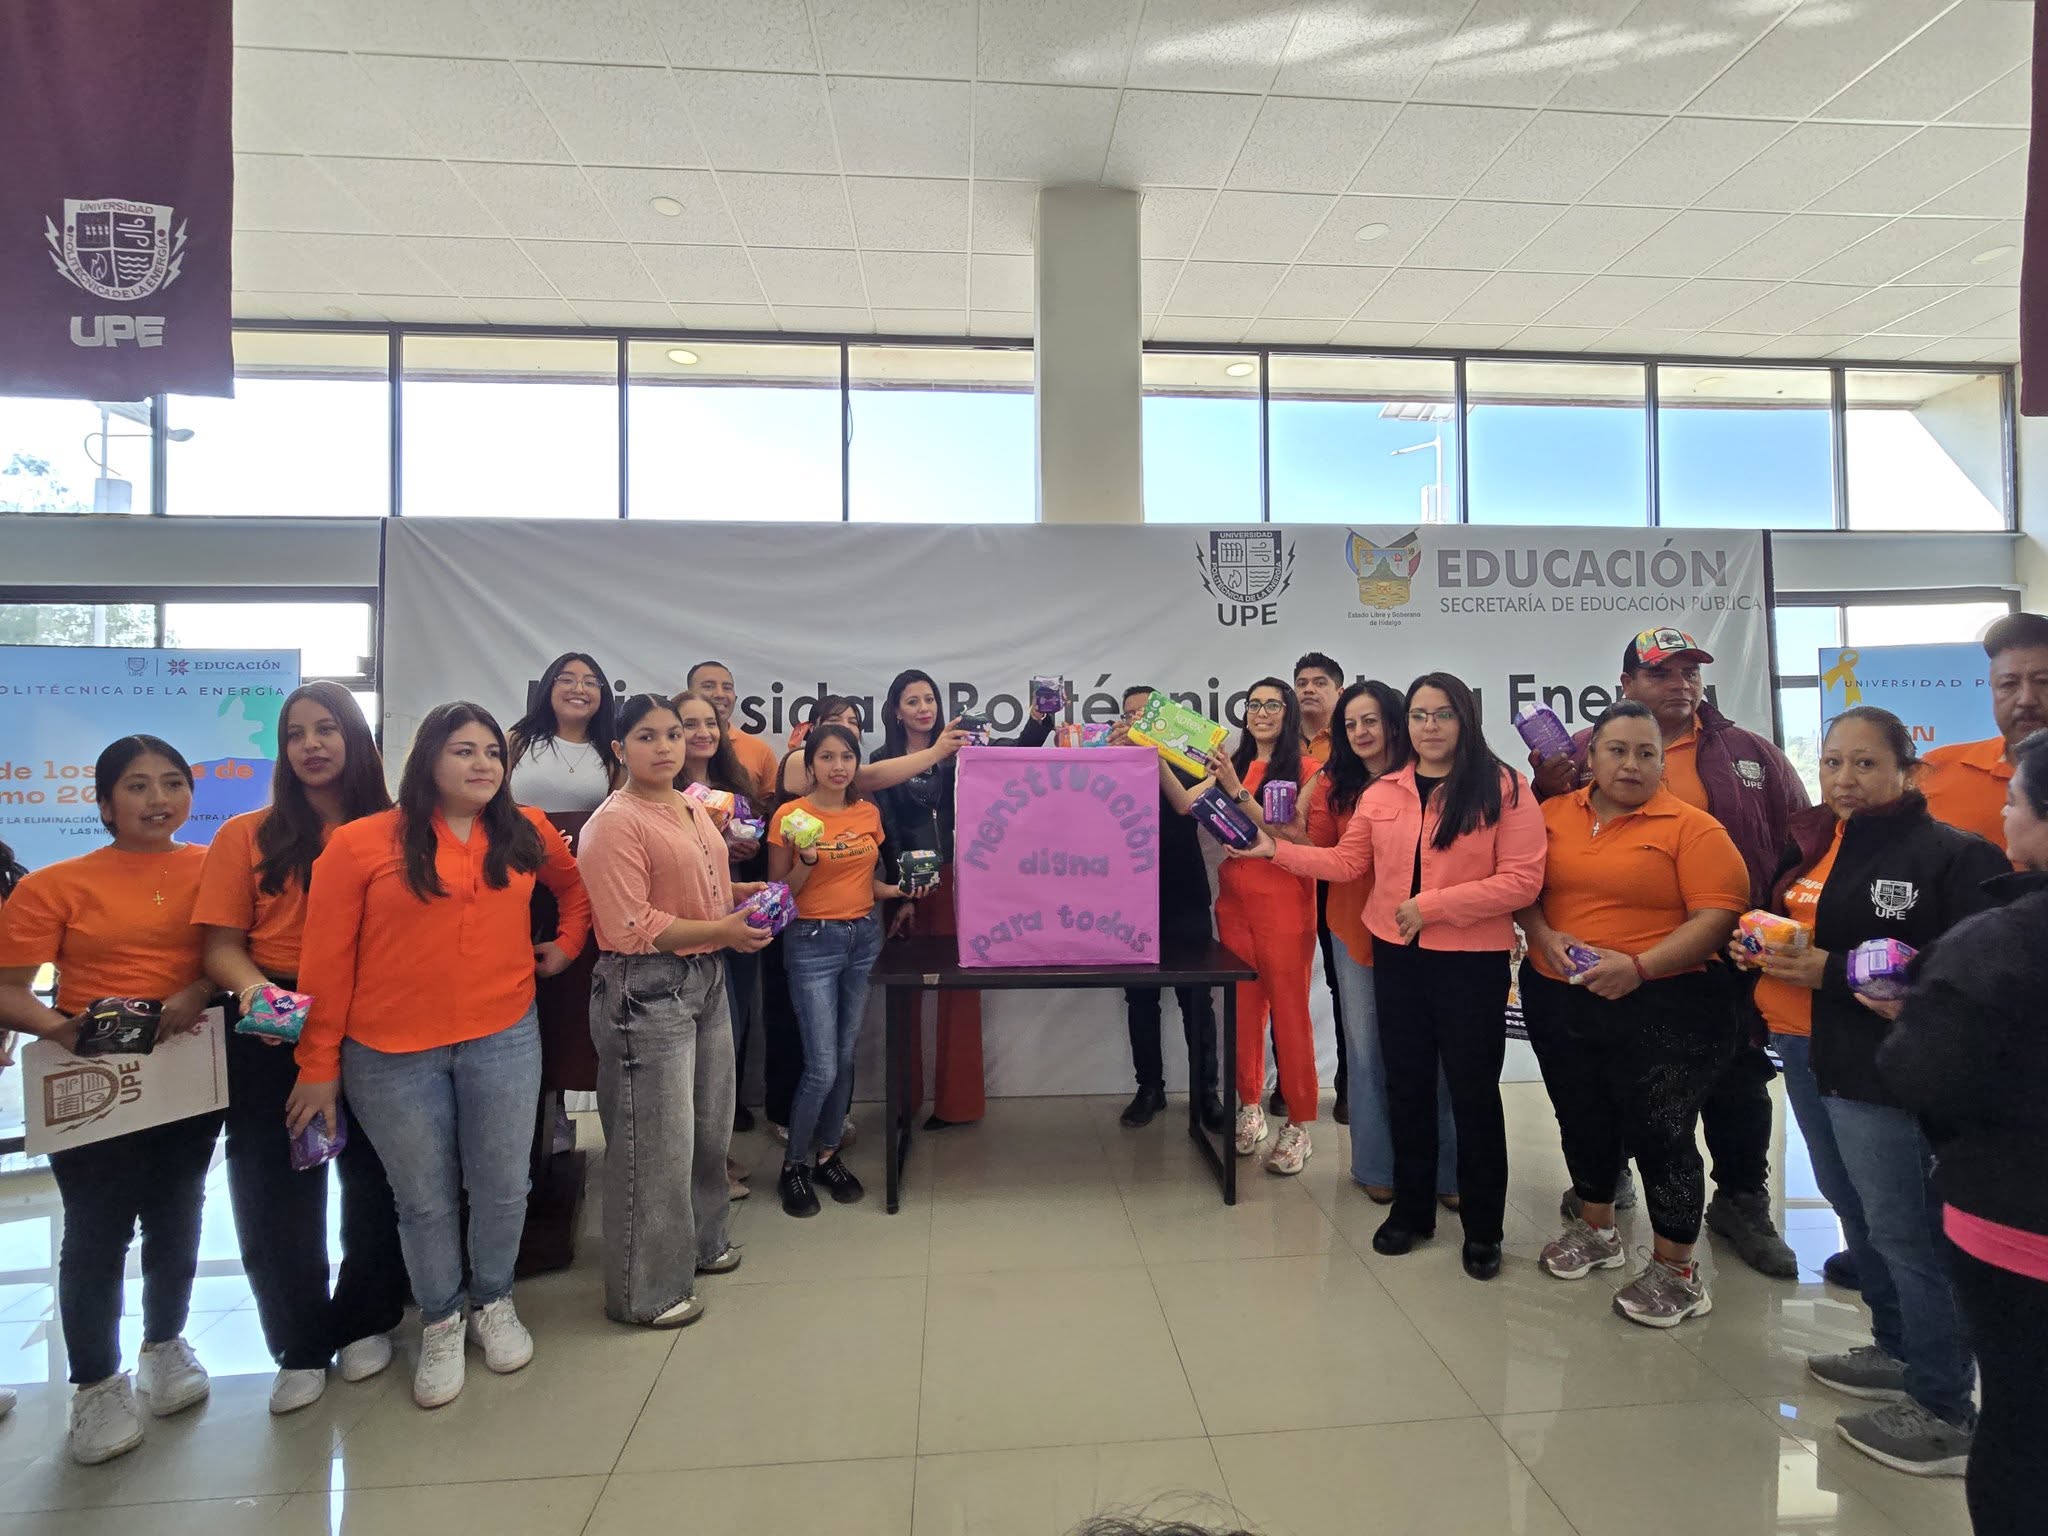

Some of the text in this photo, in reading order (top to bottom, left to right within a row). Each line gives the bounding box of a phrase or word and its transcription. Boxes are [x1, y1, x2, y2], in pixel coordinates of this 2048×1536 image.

[80, 202, 154, 215] UNIVERSIDAD
[112, 290, 131, 298] DE
[131, 285, 149, 297] LA
[70, 315, 165, 348] UPE
[1219, 531, 1273, 539] UNIVERSIDAD
[1437, 538, 1727, 588] EDUCACIÓN
[1440, 593, 1546, 613] SECRETARÍA
[1552, 596, 1574, 612] DE
[1580, 592, 1685, 612] EDUCACIÓN
[1217, 602, 1278, 627] UPE
[1347, 611, 1369, 619] Estado
[194, 659, 281, 670] EDUCACIÓN
[1844, 679, 1962, 688] UNIVERSIDAD
[133, 686, 154, 695] DE
[164, 686, 188, 696] LA
[199, 685, 285, 696] ENERGÍA
[44, 760, 96, 780] los
[215, 759, 255, 779] de
[1742, 778, 1763, 790] UPE
[24, 815, 98, 824] ELIMINACIÓN
[70, 827, 91, 835] LAS
[1018, 847, 1110, 877] digna
[1875, 906, 1907, 920] UPE
[969, 904, 1151, 961] para todas
[274, 999, 295, 1010] Saba
[118, 1060, 142, 1105] UPE
